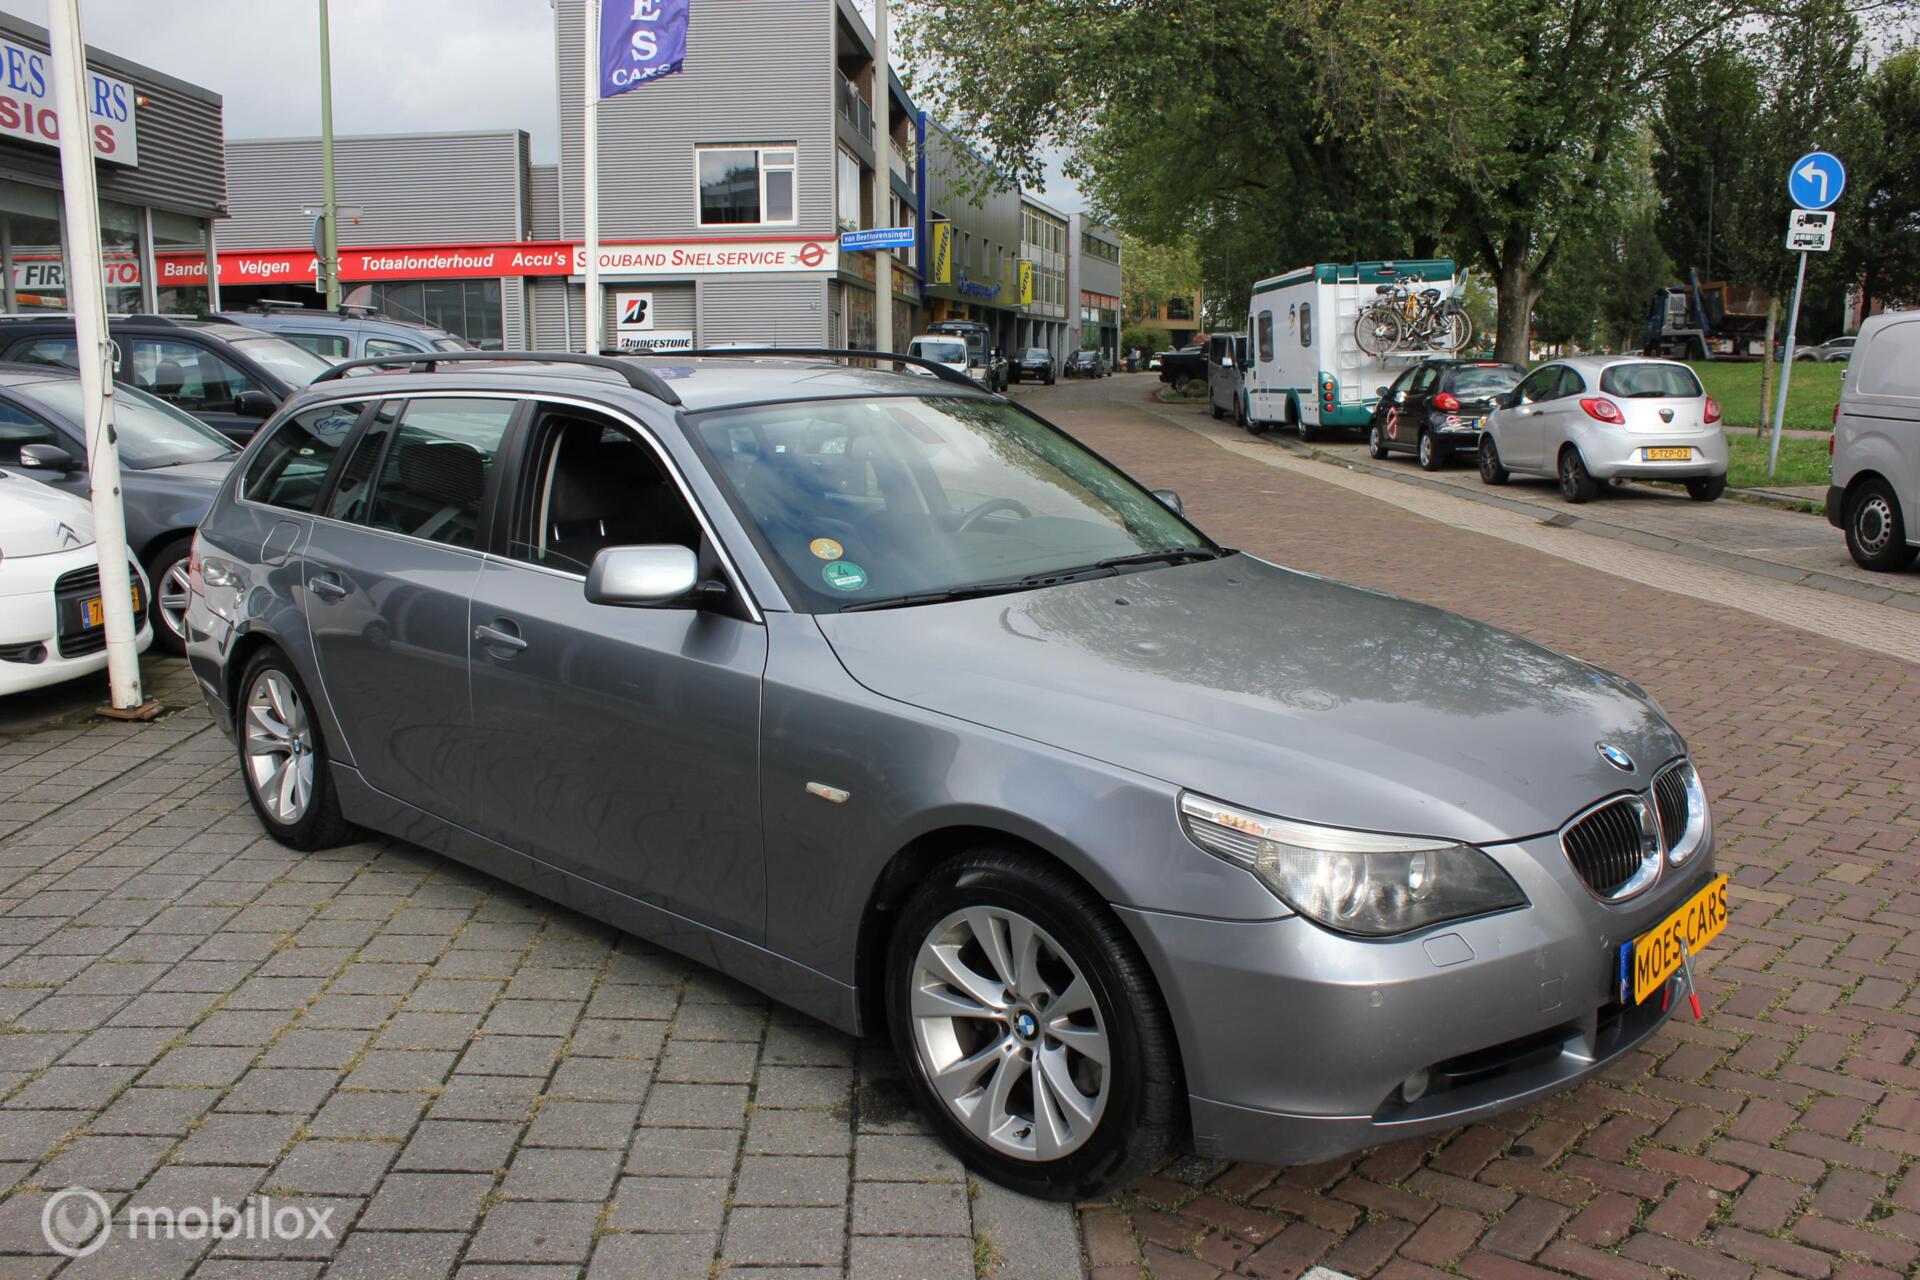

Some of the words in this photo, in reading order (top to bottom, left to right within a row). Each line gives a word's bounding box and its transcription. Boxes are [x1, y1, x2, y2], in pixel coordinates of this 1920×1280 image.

[0, 45, 46, 98] ES
[90, 76, 128, 123] RS
[0, 95, 116, 154] SIOS
[238, 260, 290, 277] Velgen
[361, 253, 495, 271] Totaalonderhoud
[511, 251, 567, 267] Accu's
[576, 250, 667, 268] SOUBAND
[671, 249, 786, 267] SNELSERVICE
[620, 337, 691, 348] BRIDGESTONE
[1637, 919, 1683, 993] MOES
[1686, 883, 1728, 947] CARS
